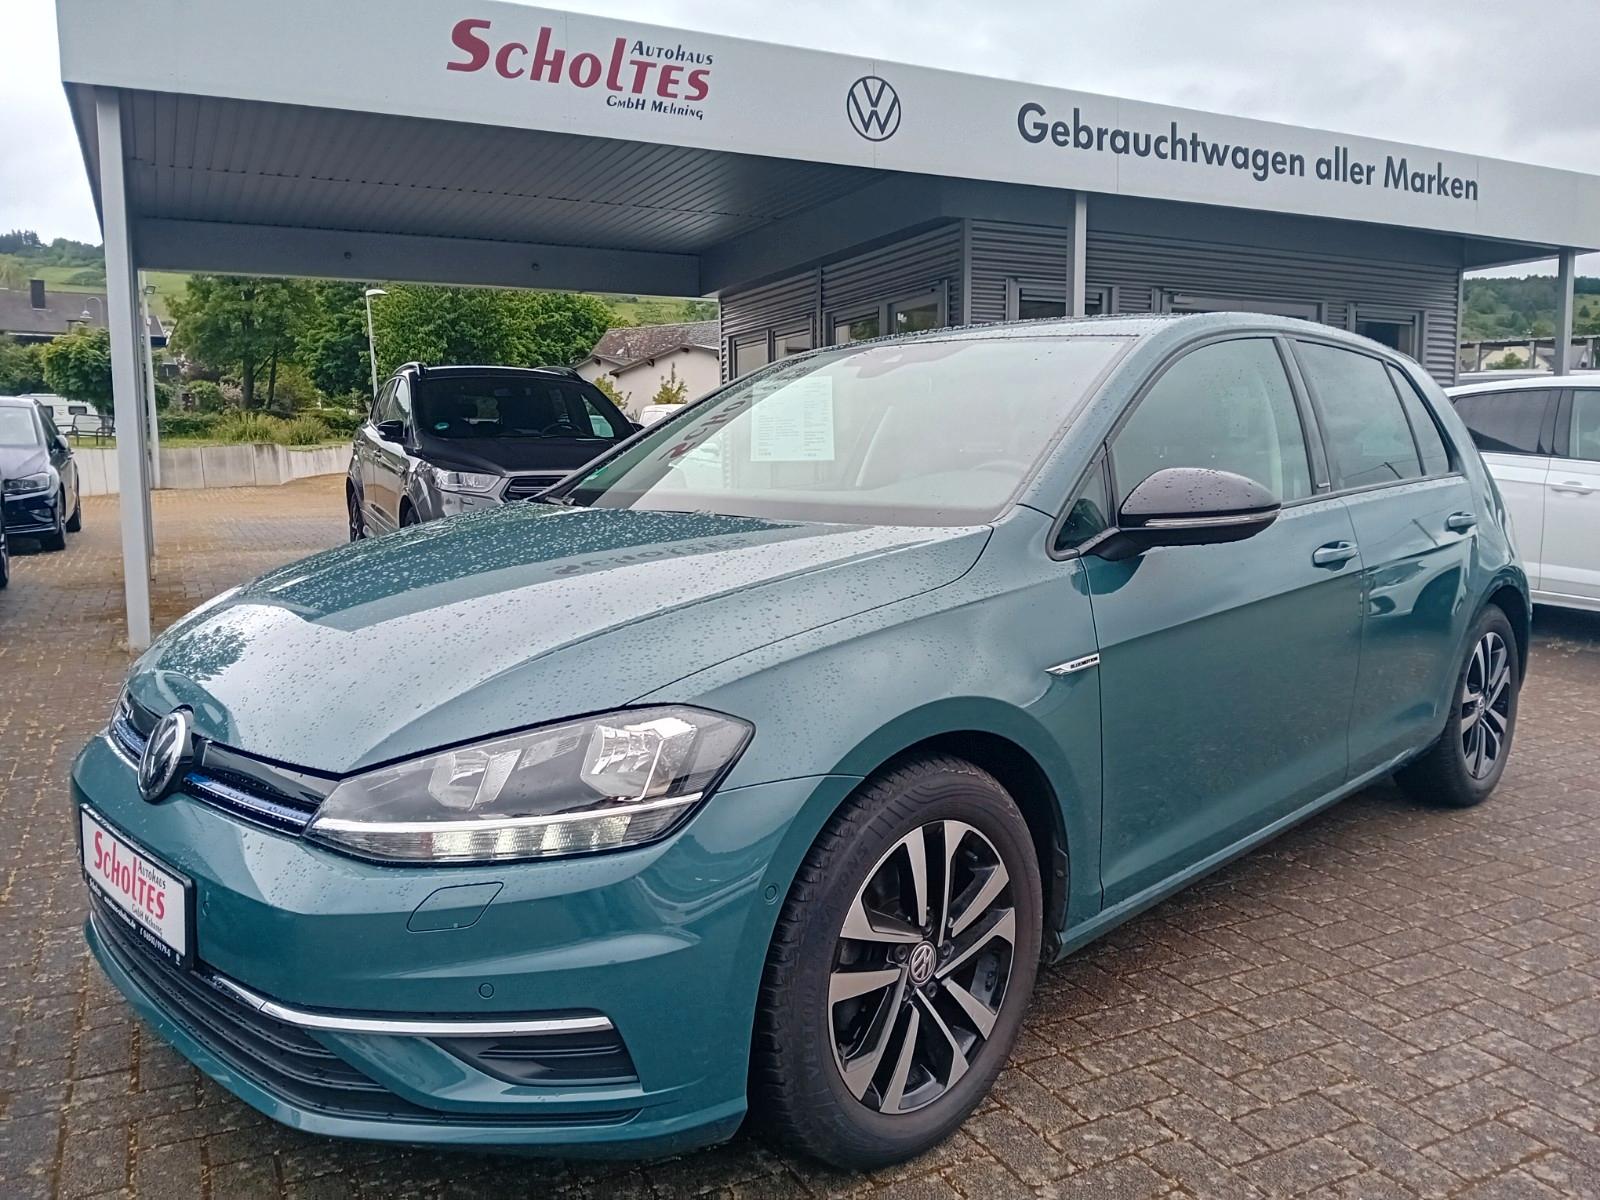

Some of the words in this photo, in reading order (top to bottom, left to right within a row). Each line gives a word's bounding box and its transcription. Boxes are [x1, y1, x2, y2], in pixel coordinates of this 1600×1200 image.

[847, 76, 901, 142] VW
[1017, 101, 1305, 182] Gebrauchtwagen
[1315, 145, 1376, 186] aller
[1383, 156, 1479, 201] Marken
